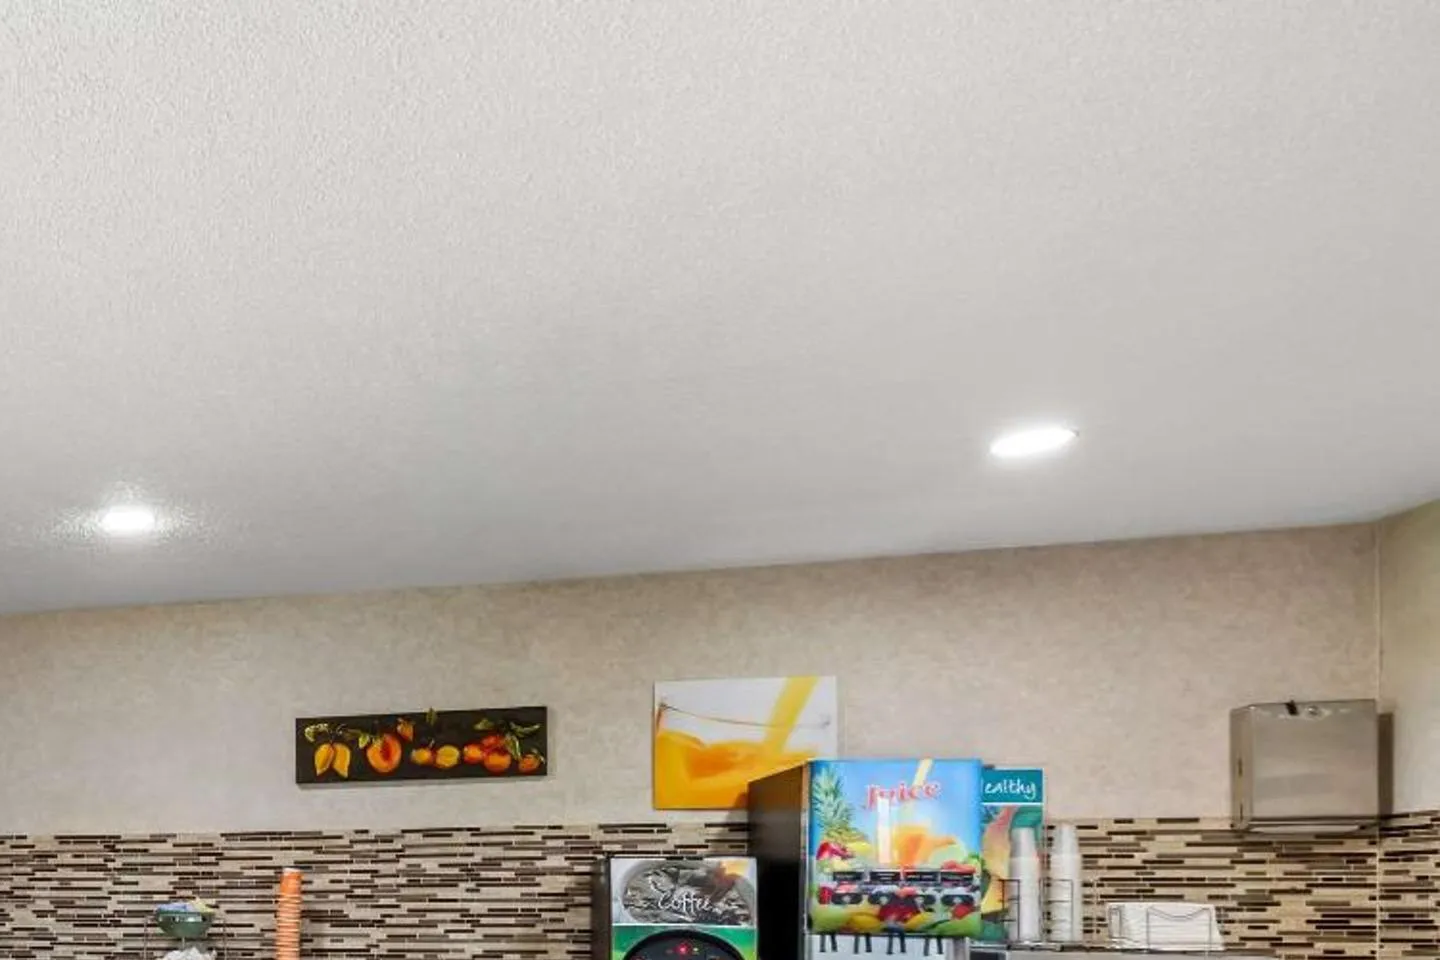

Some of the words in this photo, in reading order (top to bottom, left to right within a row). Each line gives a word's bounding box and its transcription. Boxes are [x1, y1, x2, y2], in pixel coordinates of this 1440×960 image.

[865, 780, 941, 810] Juice
[982, 777, 1037, 800] ealthy
[657, 890, 713, 913] Coffee
